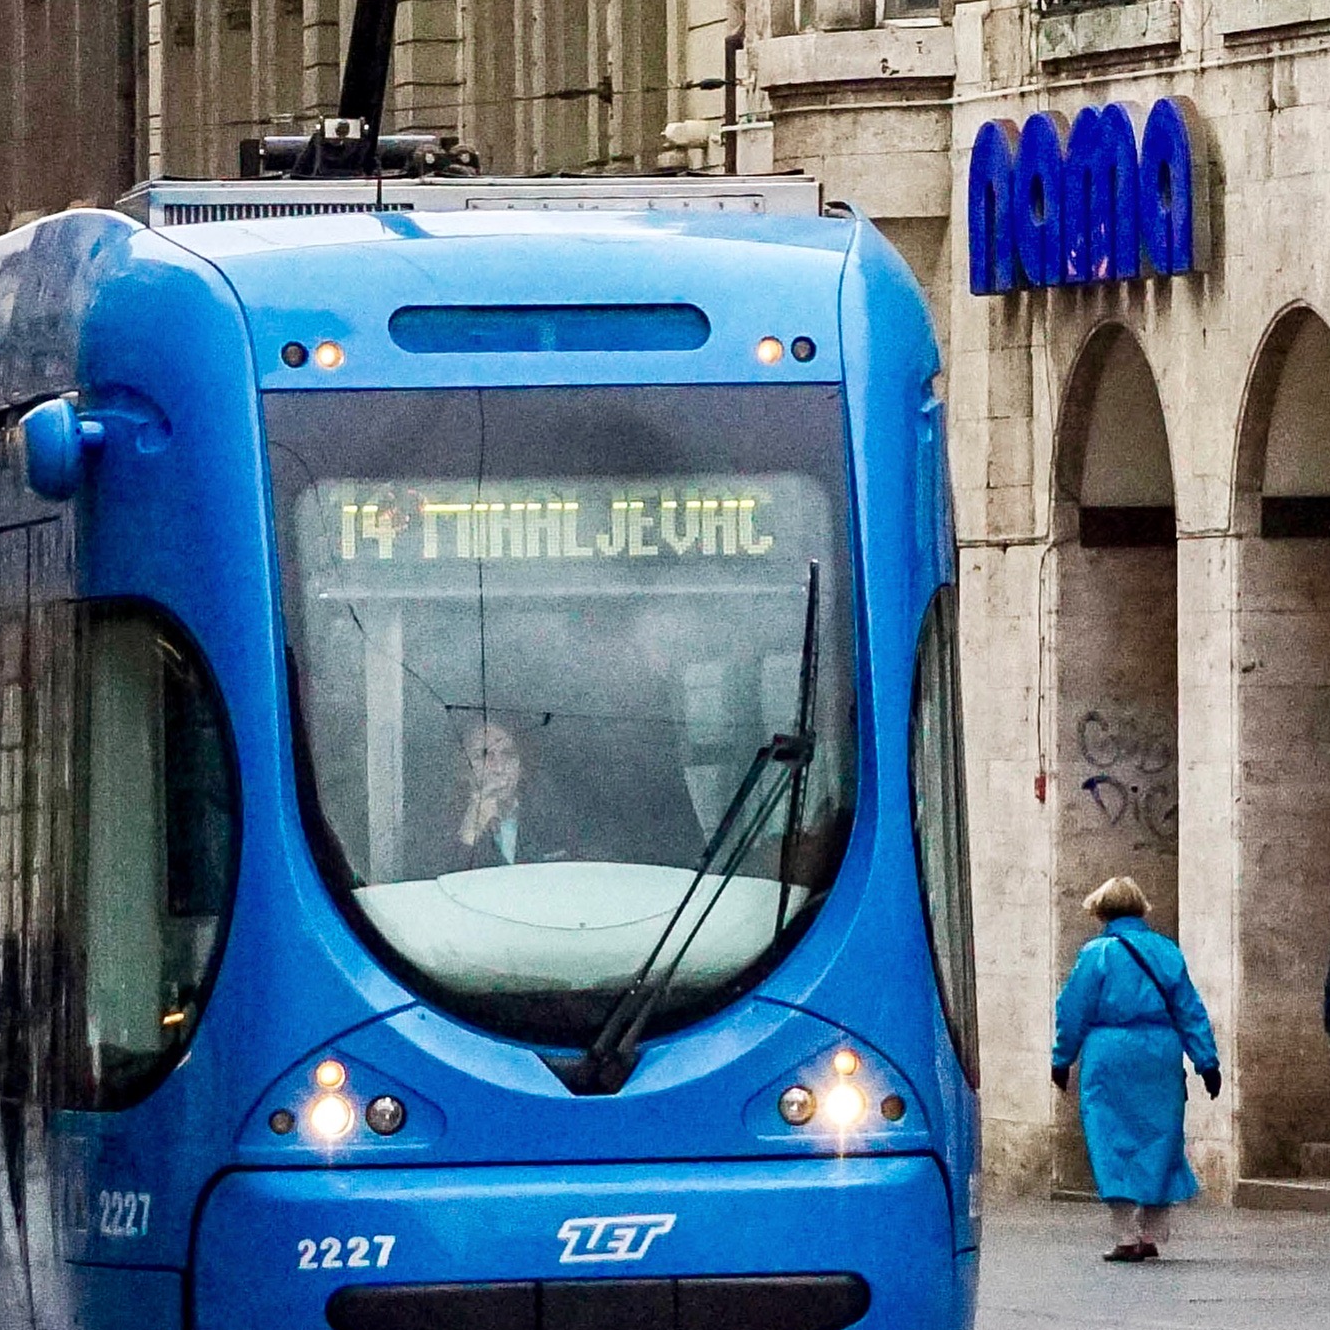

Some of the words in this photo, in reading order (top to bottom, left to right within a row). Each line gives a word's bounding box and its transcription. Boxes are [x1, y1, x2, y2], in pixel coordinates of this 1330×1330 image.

[341, 497, 396, 559] 14
[99, 1189, 151, 1237] 2227
[297, 1235, 397, 1270] 2227
[557, 1213, 677, 1264] ZET
